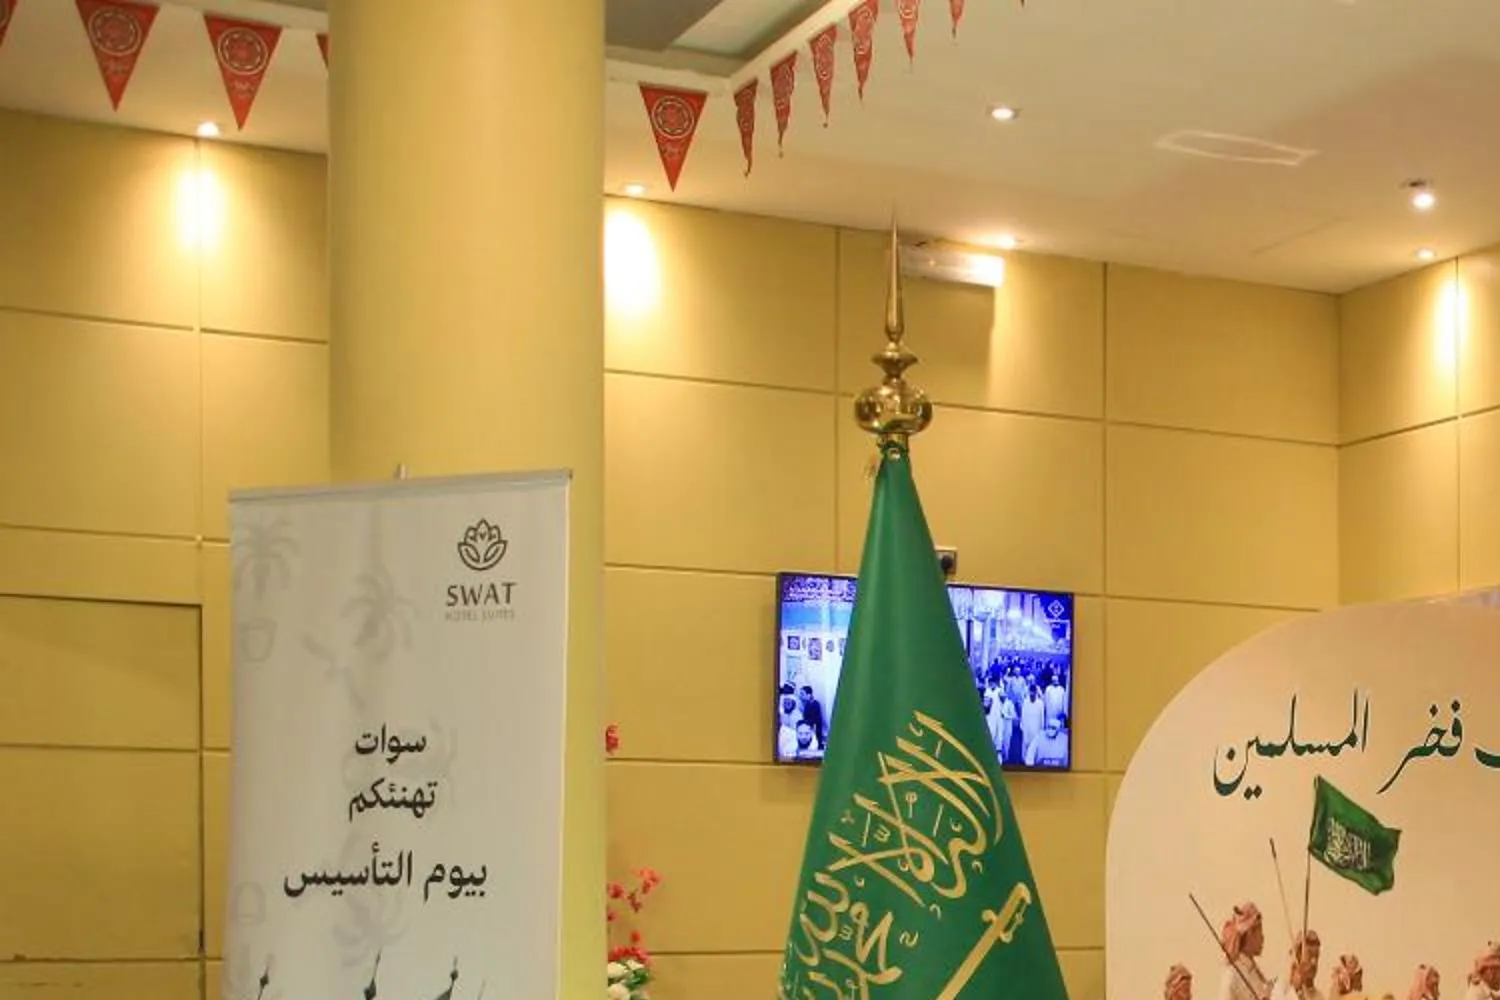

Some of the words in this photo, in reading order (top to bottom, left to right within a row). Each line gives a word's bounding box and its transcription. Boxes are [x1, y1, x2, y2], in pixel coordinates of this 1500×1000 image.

[446, 582, 519, 606] SWAT
[354, 723, 427, 764] سوات
[1213, 688, 1370, 800] المسلمين
[1376, 699, 1464, 794] فخر
[348, 778, 438, 822] تهنئكم
[284, 842, 413, 898] التأسيس
[423, 859, 488, 903] بيوم
